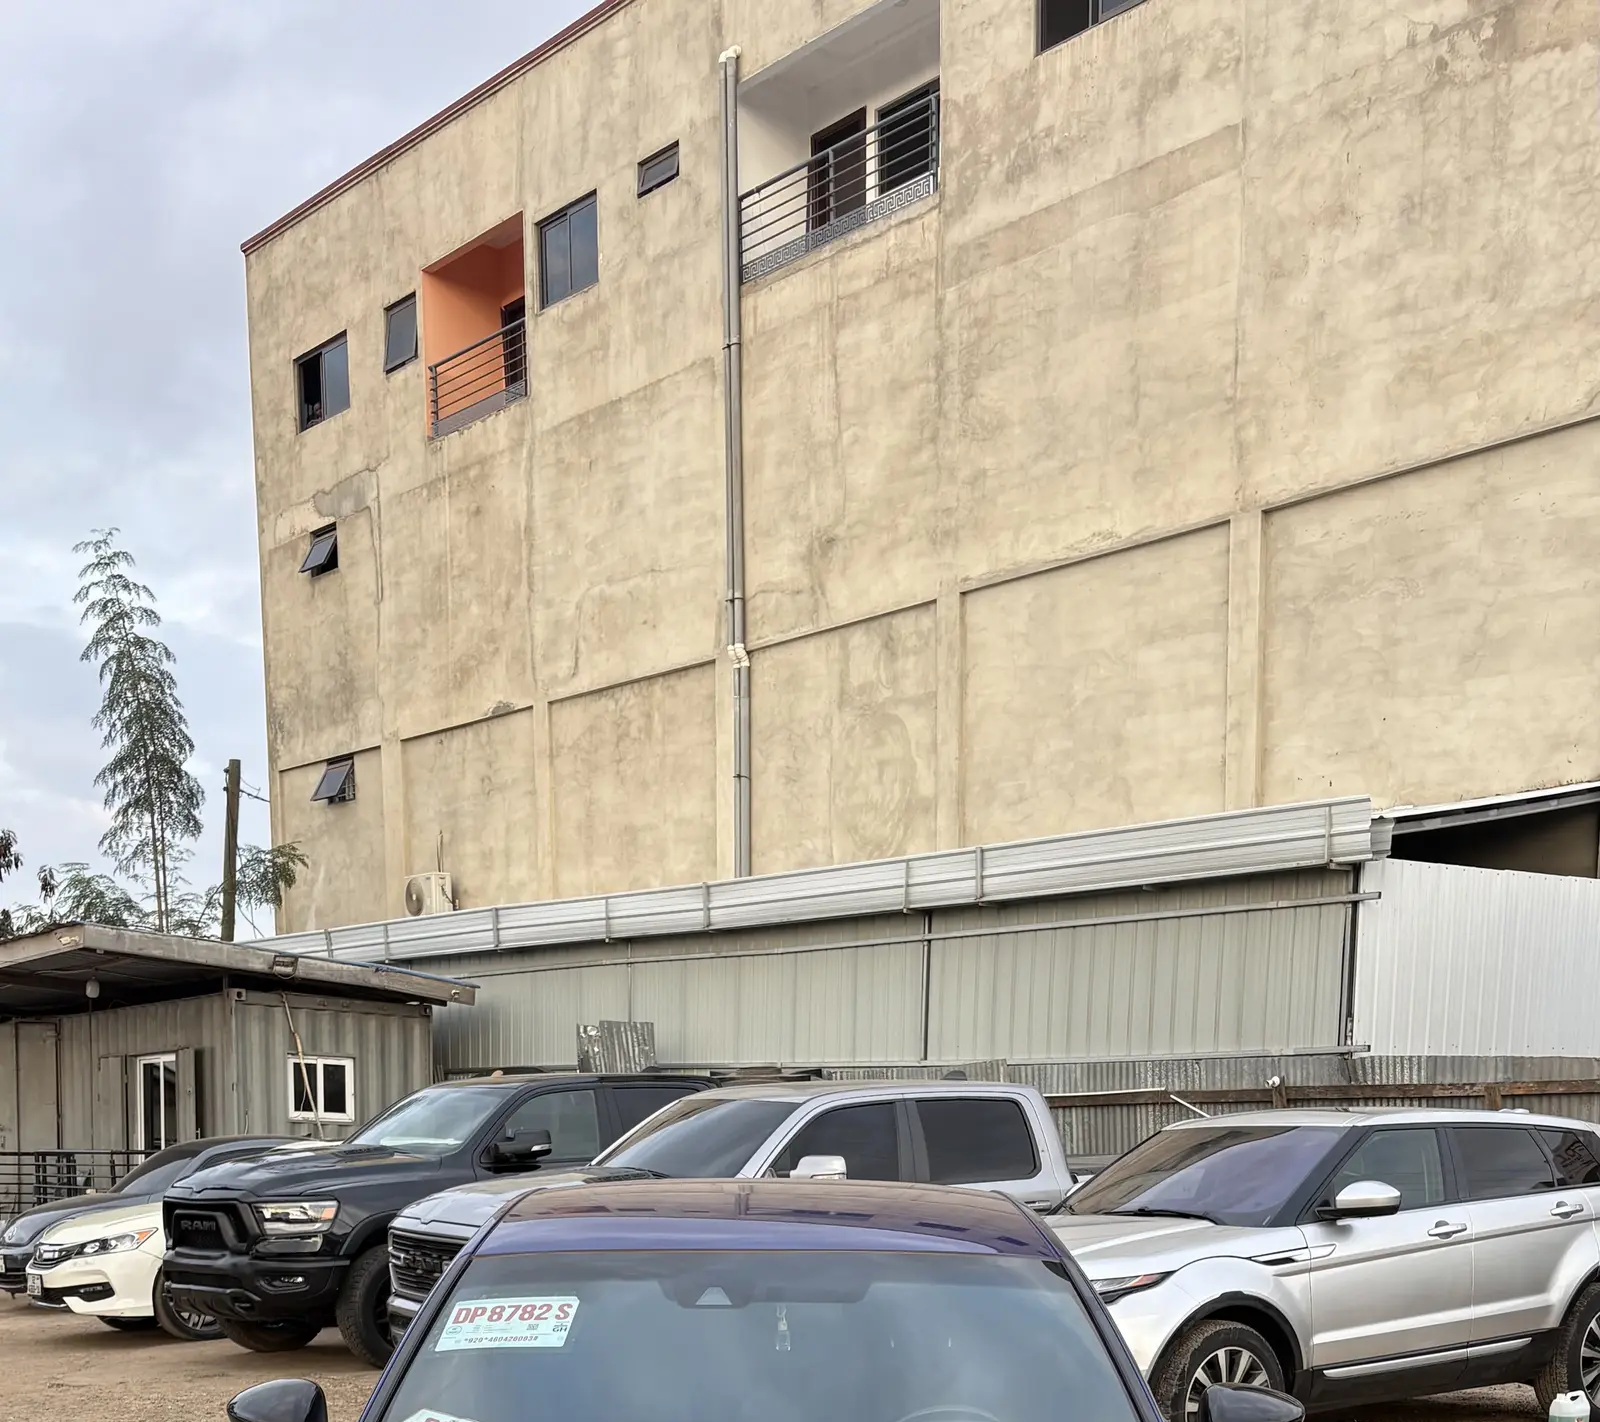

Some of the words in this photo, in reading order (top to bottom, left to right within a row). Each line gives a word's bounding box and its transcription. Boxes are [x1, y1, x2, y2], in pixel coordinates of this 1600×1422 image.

[180, 1220, 216, 1231] RAM
[452, 1307, 487, 1324] DP
[487, 1303, 552, 1322] 8782
[554, 1303, 573, 1320] S
